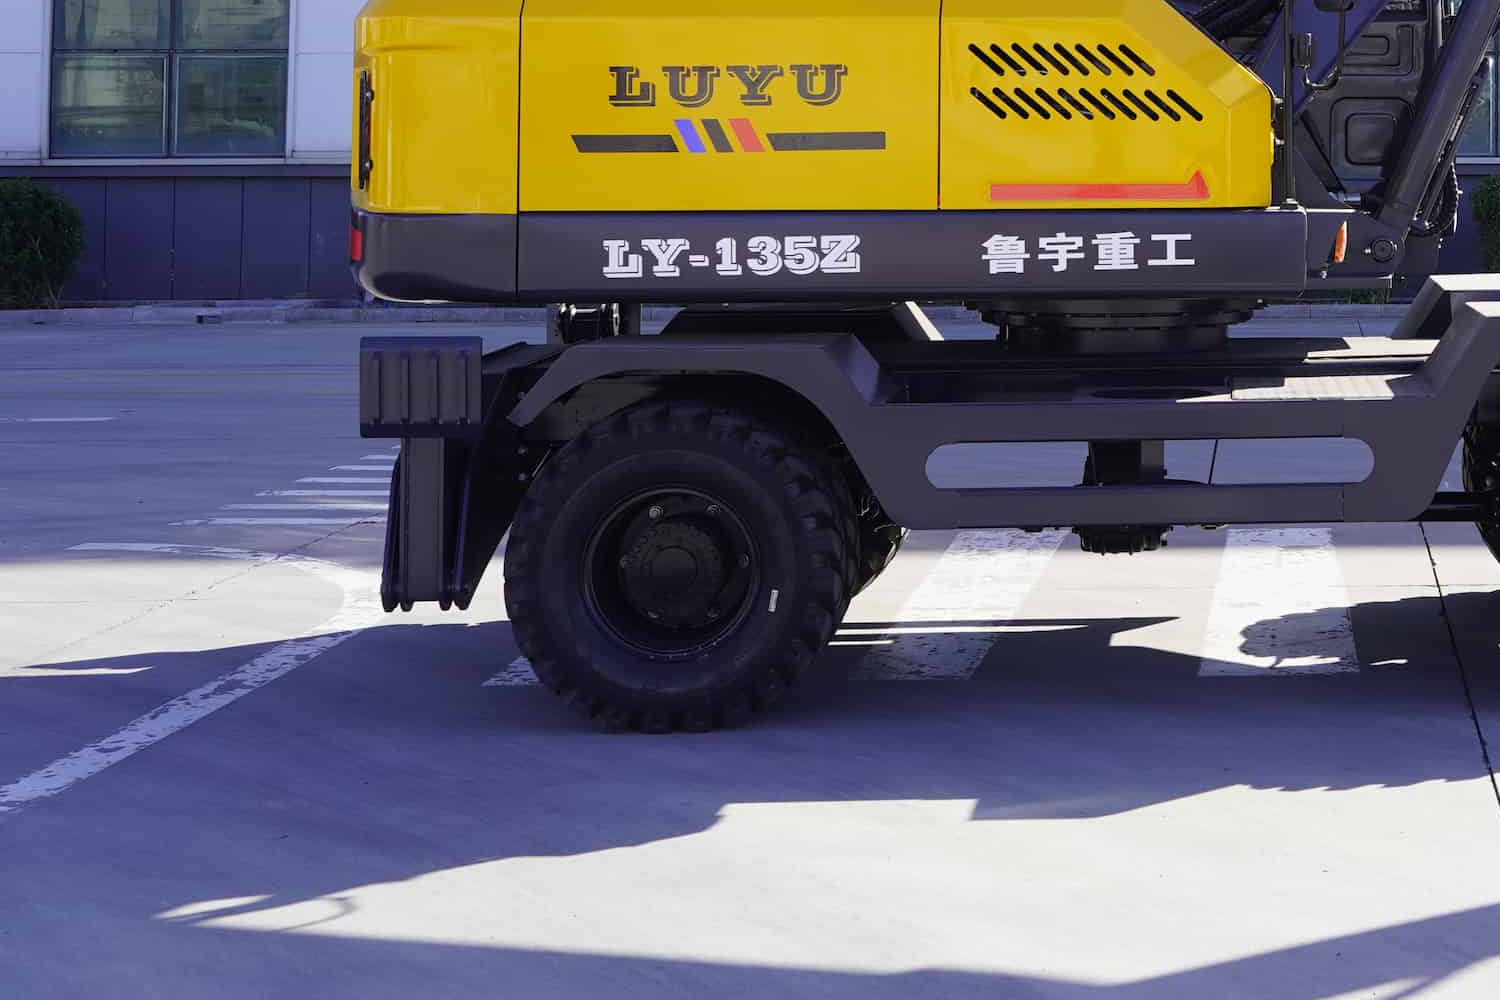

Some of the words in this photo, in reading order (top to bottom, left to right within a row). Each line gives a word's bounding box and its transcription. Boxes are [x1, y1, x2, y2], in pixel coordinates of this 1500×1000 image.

[609, 64, 848, 107] LUYU
[603, 235, 861, 278] LY-135Z
[981, 231, 1196, 275] 鲁宇重工
